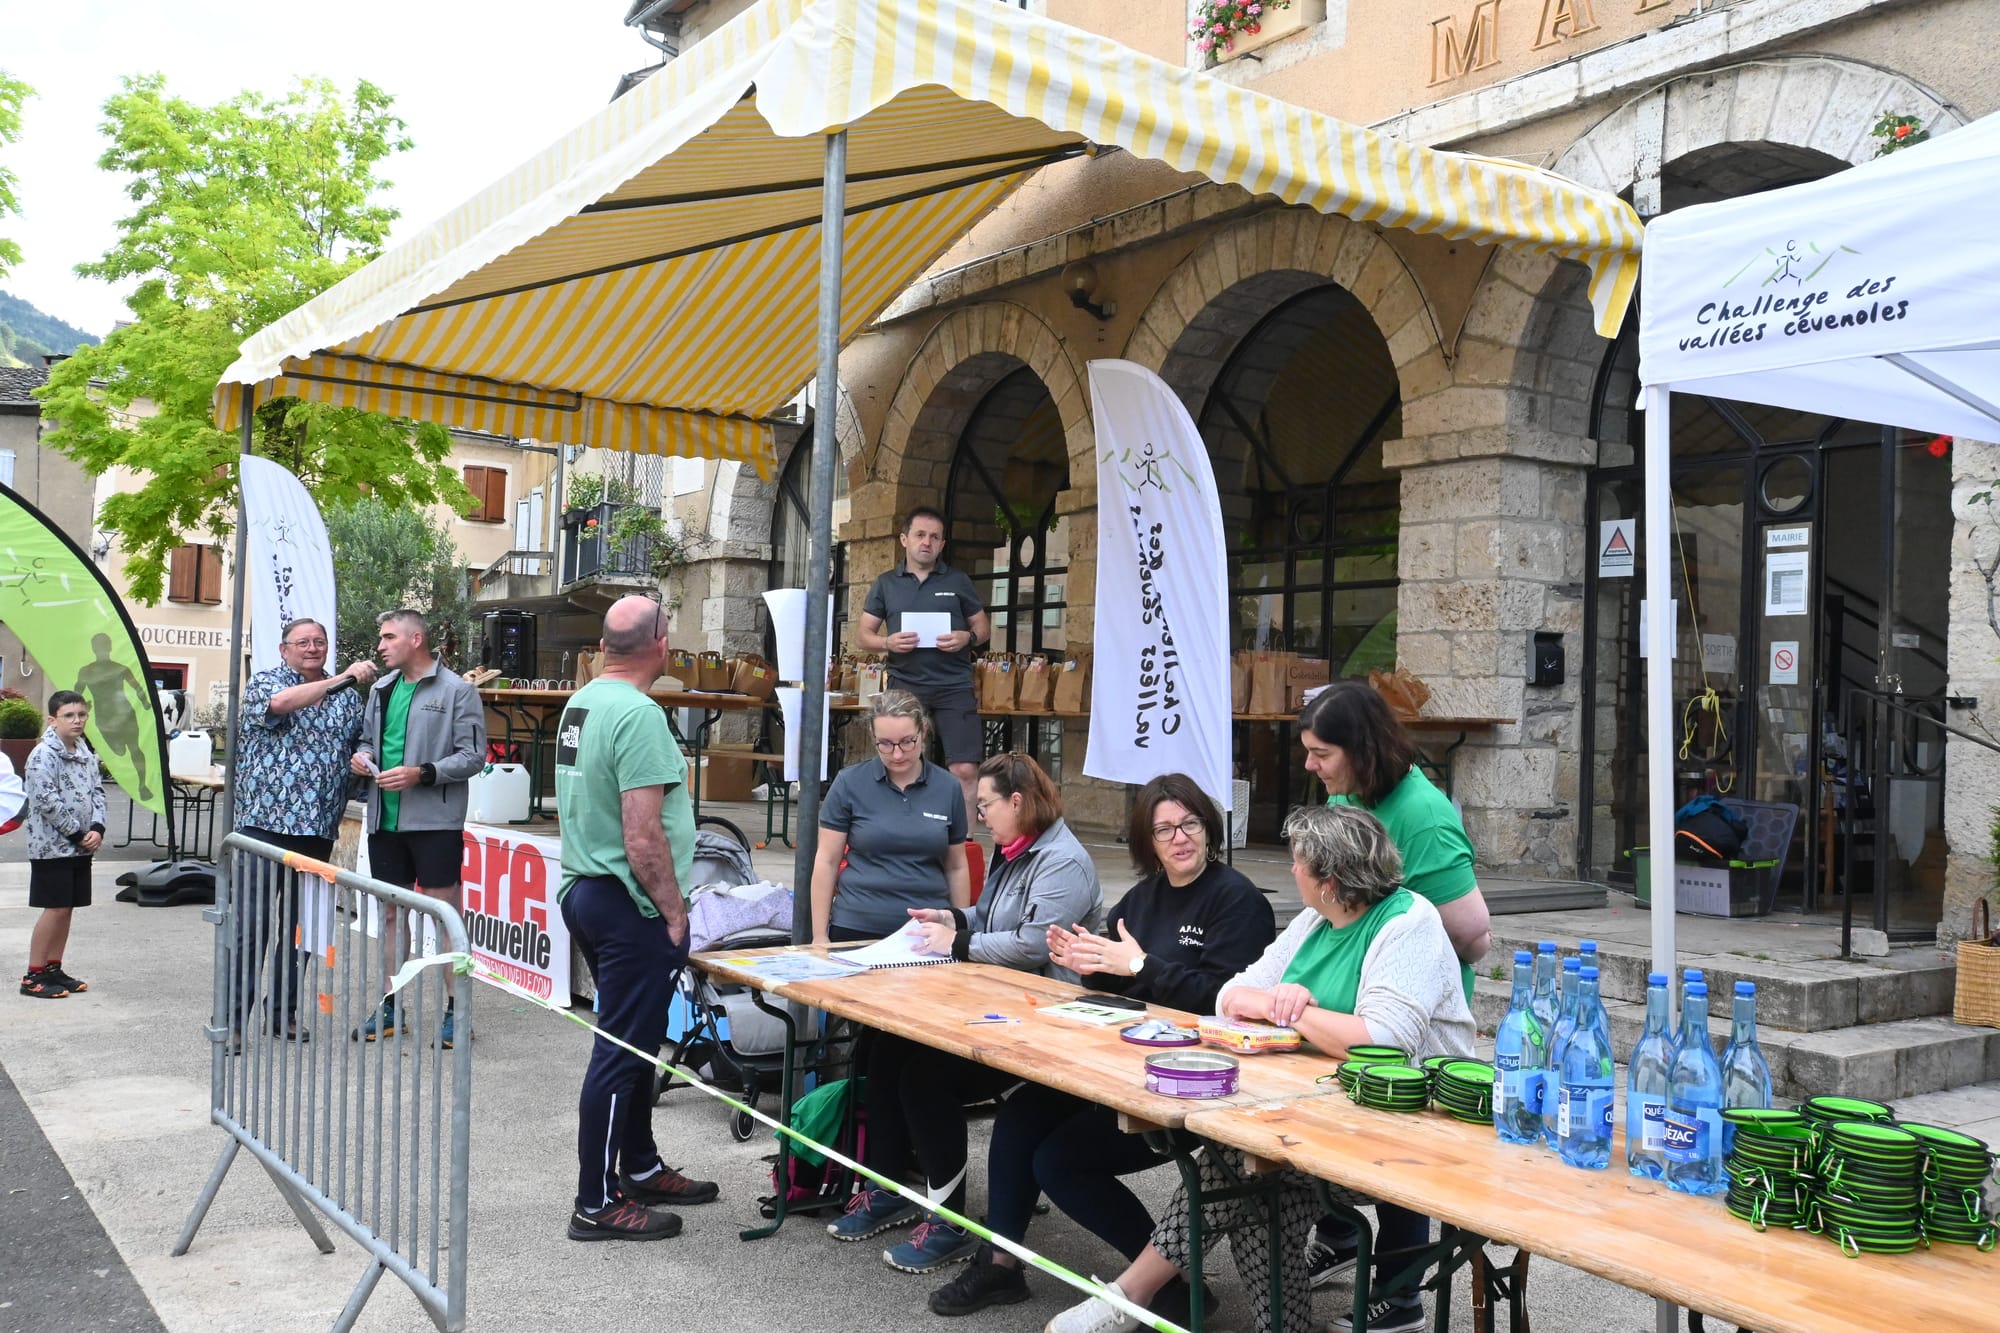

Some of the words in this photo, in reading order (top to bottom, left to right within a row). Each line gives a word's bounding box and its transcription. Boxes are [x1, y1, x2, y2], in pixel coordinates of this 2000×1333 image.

[1426, 0, 1671, 87] MA
[1696, 290, 1829, 325] Challenge
[1846, 276, 1897, 300] des
[1679, 321, 1767, 352] vallées
[1783, 300, 1910, 337] cévenoles
[1771, 532, 1804, 543] MAIRIE
[136, 627, 223, 647] OUCHERIE
[1704, 643, 1734, 657] SORTIE
[464, 909, 551, 970] nouvelle
[1644, 1105, 1665, 1117] QUÉZ
[1663, 1124, 1694, 1143] UÉZAC
